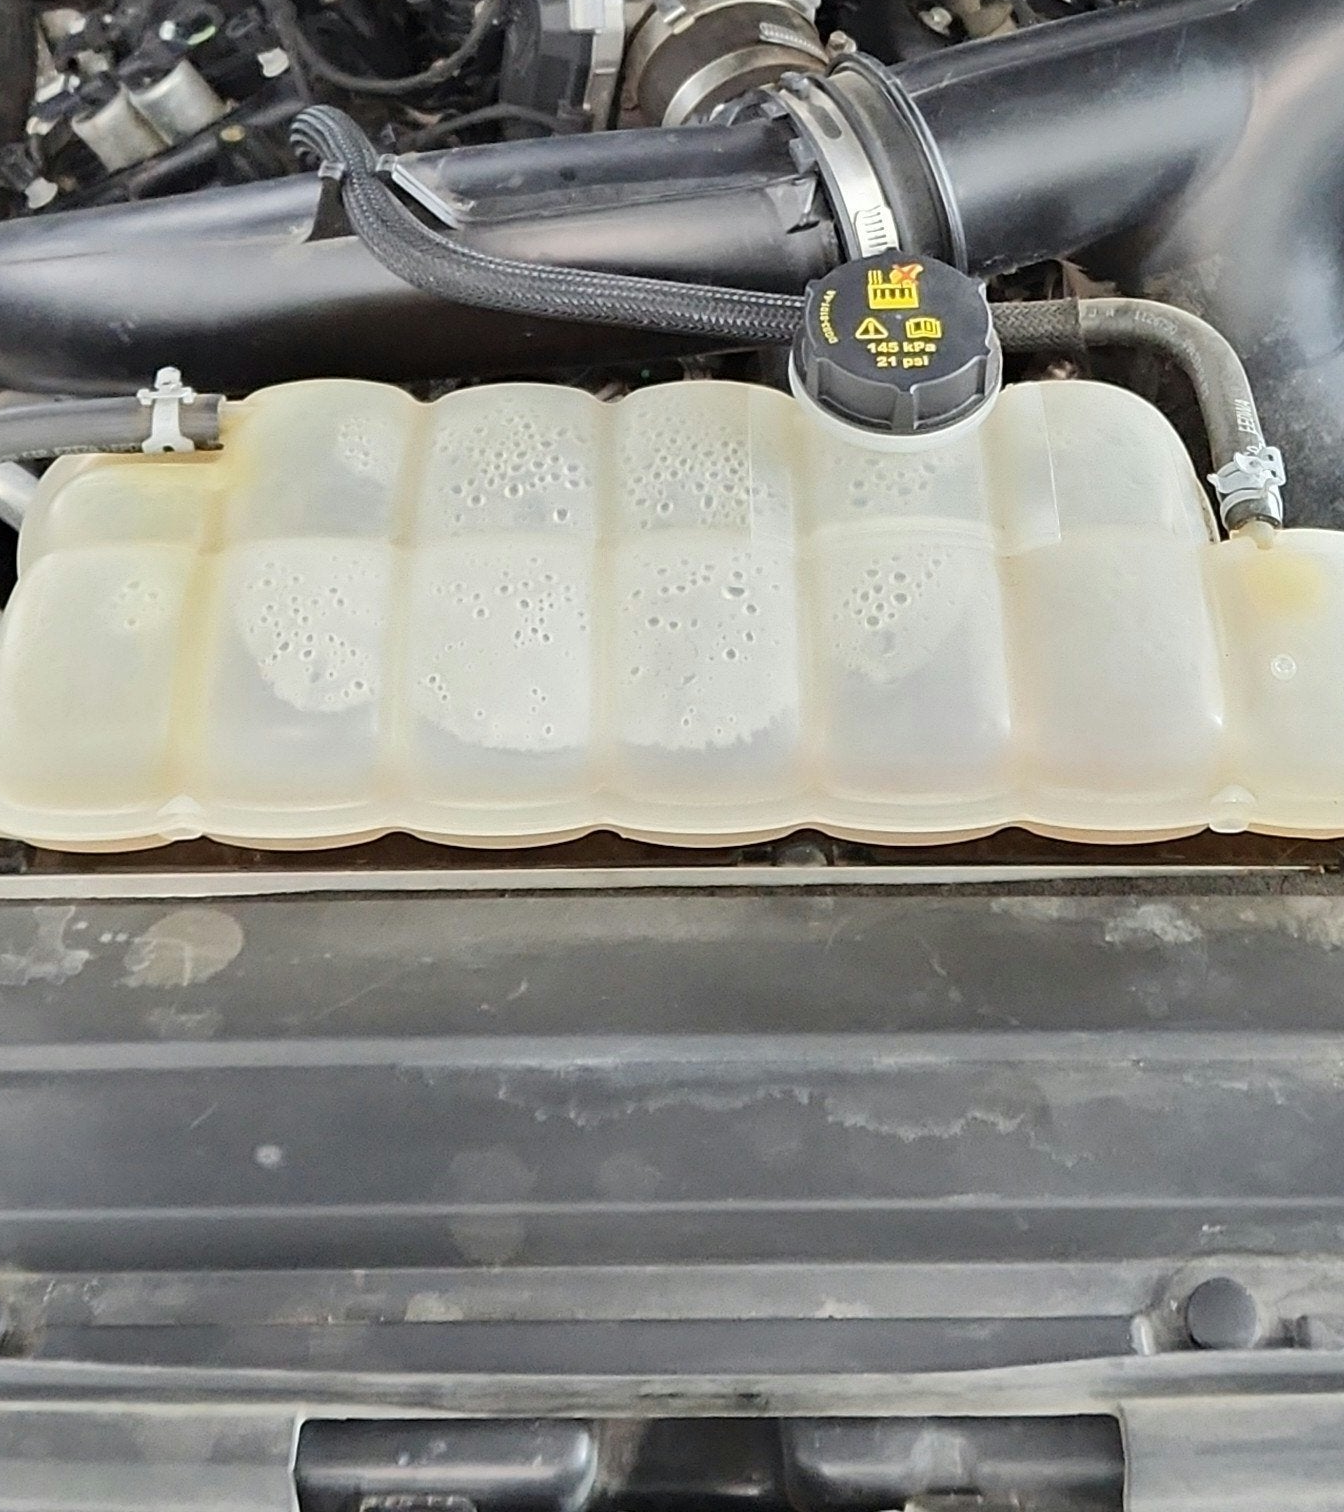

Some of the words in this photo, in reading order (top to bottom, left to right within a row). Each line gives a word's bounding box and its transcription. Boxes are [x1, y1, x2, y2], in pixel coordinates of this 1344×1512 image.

[867, 341, 899, 354] 145
[902, 341, 936, 353] kPa
[876, 355, 897, 367] 21
[902, 355, 929, 368] psi
